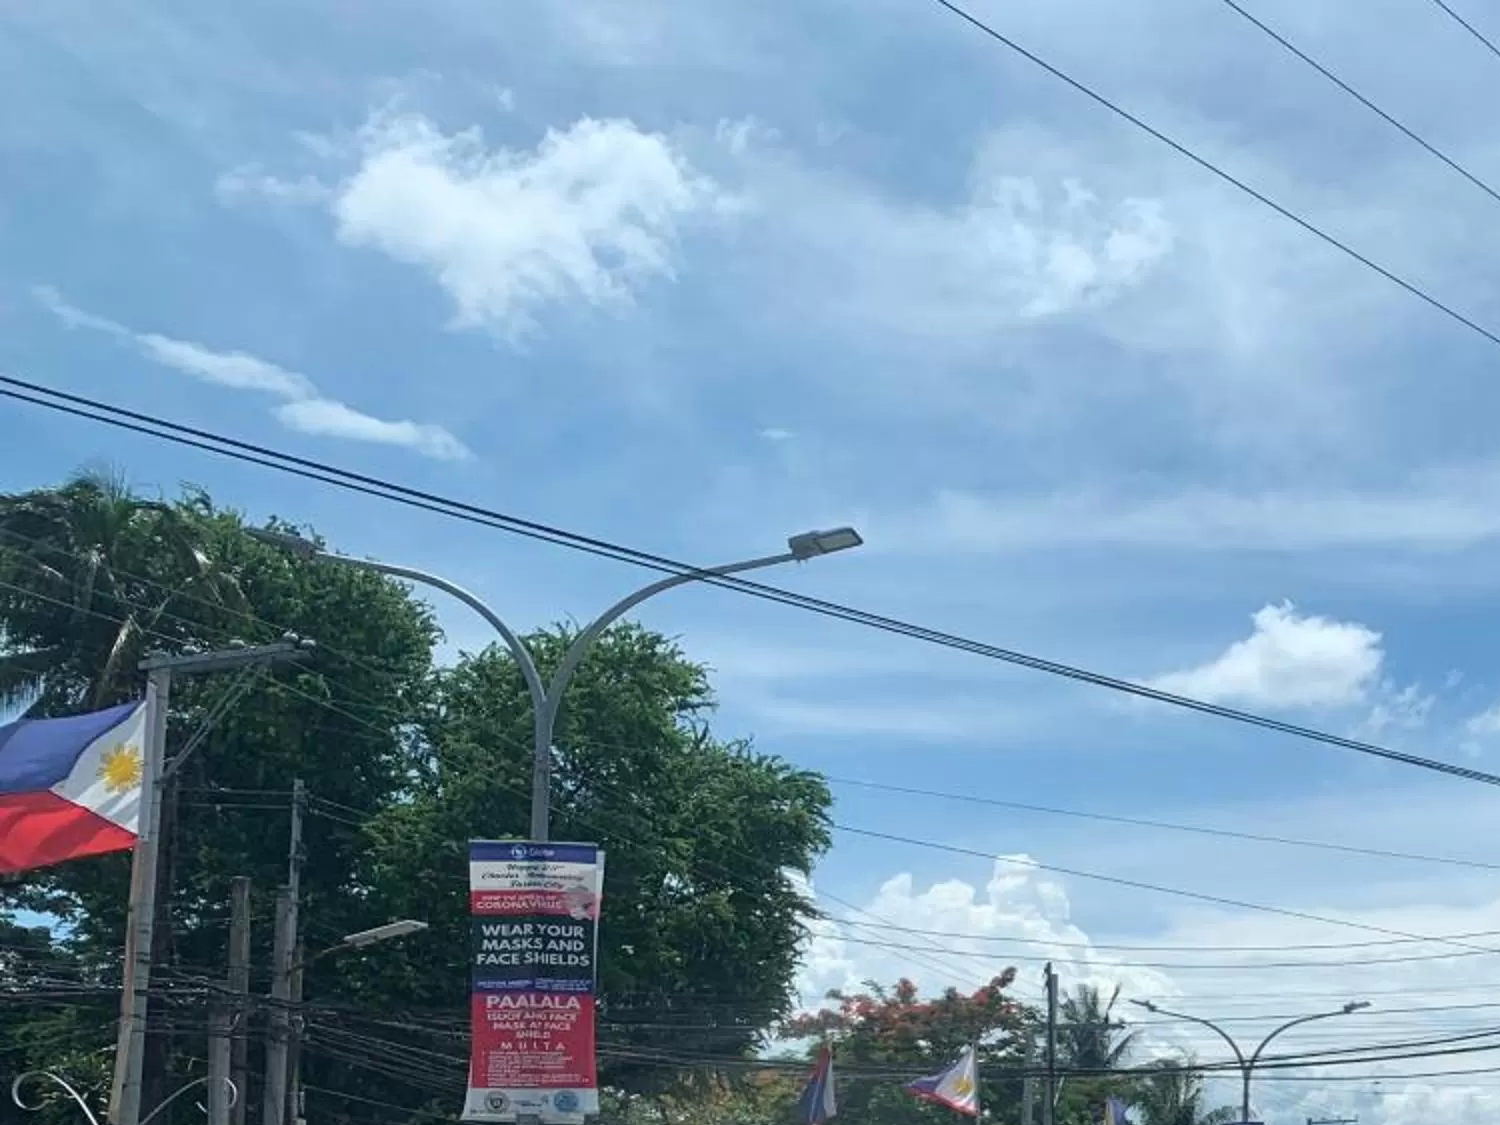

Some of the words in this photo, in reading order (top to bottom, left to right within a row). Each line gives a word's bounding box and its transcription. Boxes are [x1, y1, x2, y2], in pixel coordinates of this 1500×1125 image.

[481, 923, 534, 936] WEAR
[536, 923, 585, 938] YOUR
[482, 938, 543, 951] MASKS
[546, 939, 585, 951] AND
[476, 953, 520, 965] FACE
[523, 952, 590, 966] SHIELDS
[486, 993, 581, 1009] PAALALA
[493, 1021, 525, 1031] MASK
[544, 1021, 572, 1032] FACE
